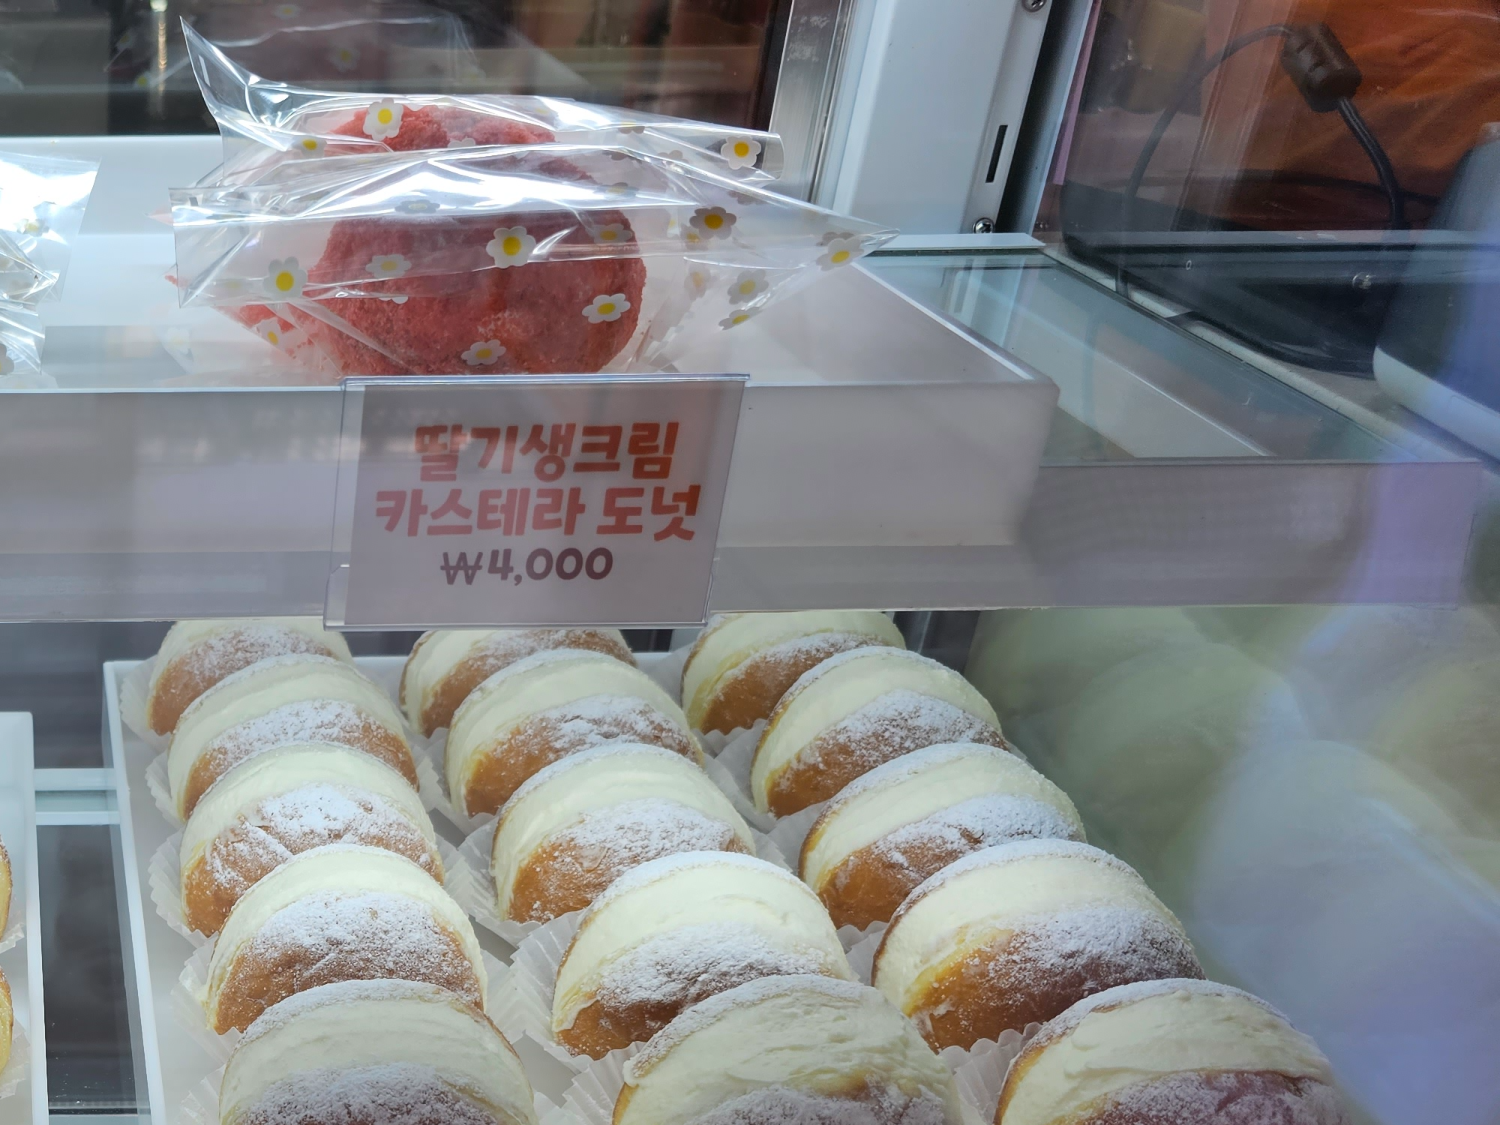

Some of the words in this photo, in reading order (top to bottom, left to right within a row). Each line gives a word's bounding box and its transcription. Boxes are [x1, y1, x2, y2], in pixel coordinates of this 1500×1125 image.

[414, 421, 680, 483] 딸기생크림
[375, 487, 585, 537] 카스테라
[596, 484, 702, 542] 도넛
